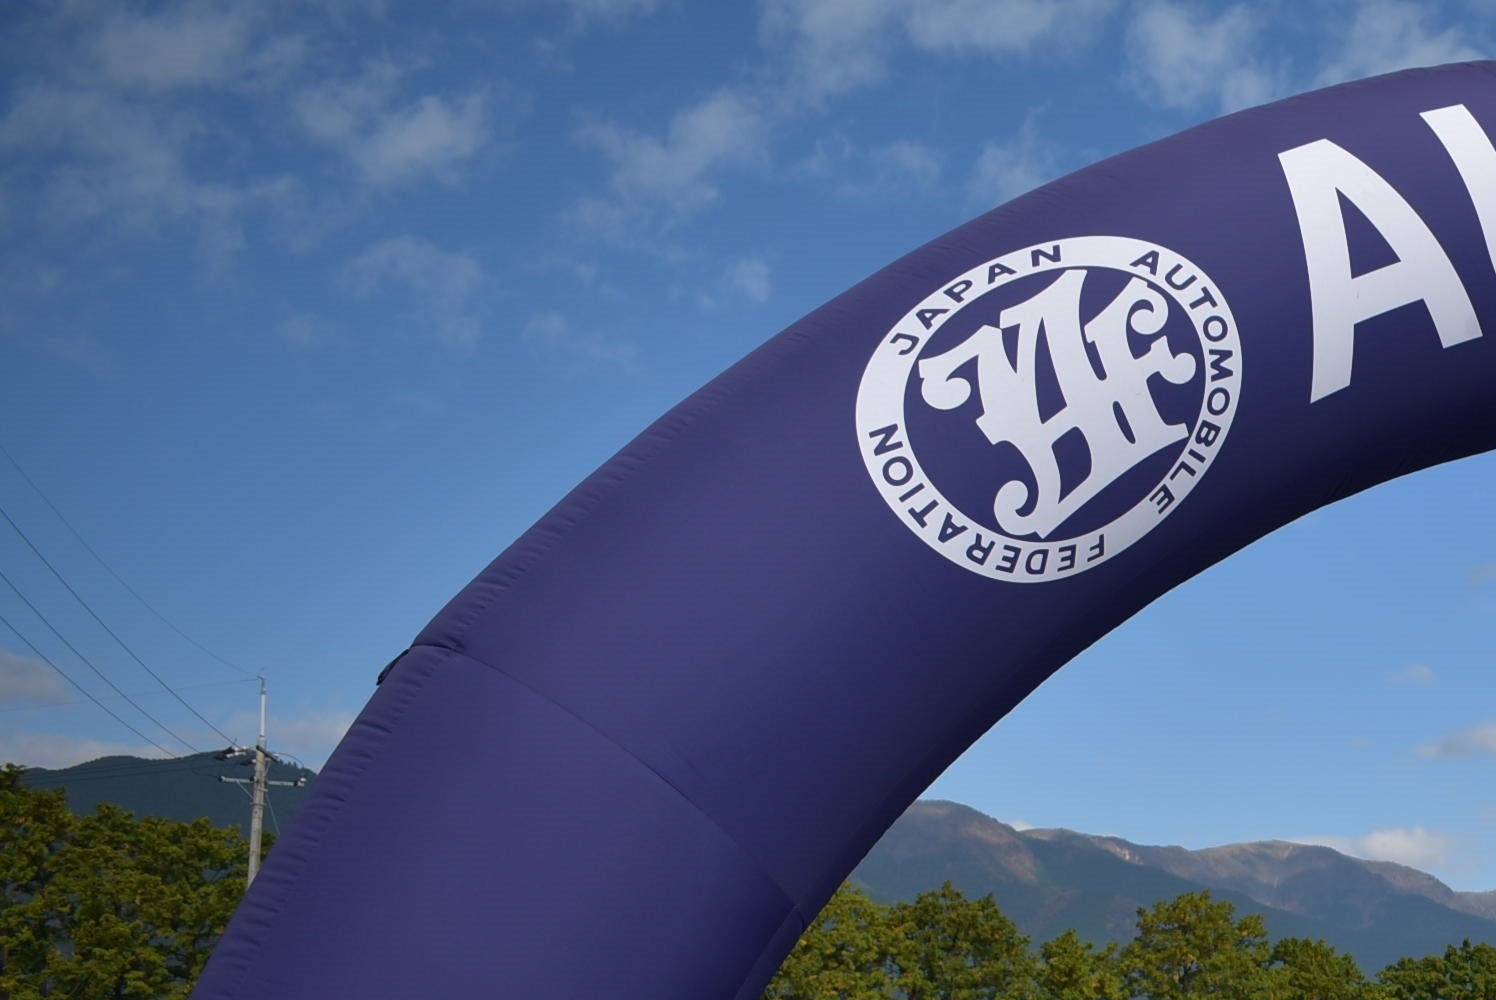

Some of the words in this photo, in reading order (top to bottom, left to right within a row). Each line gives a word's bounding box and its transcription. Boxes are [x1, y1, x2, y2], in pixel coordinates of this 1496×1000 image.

[889, 244, 1062, 355] JAPAN
[1129, 249, 1233, 514] AUTOMOBILE
[868, 423, 1105, 575] FEDERATION
